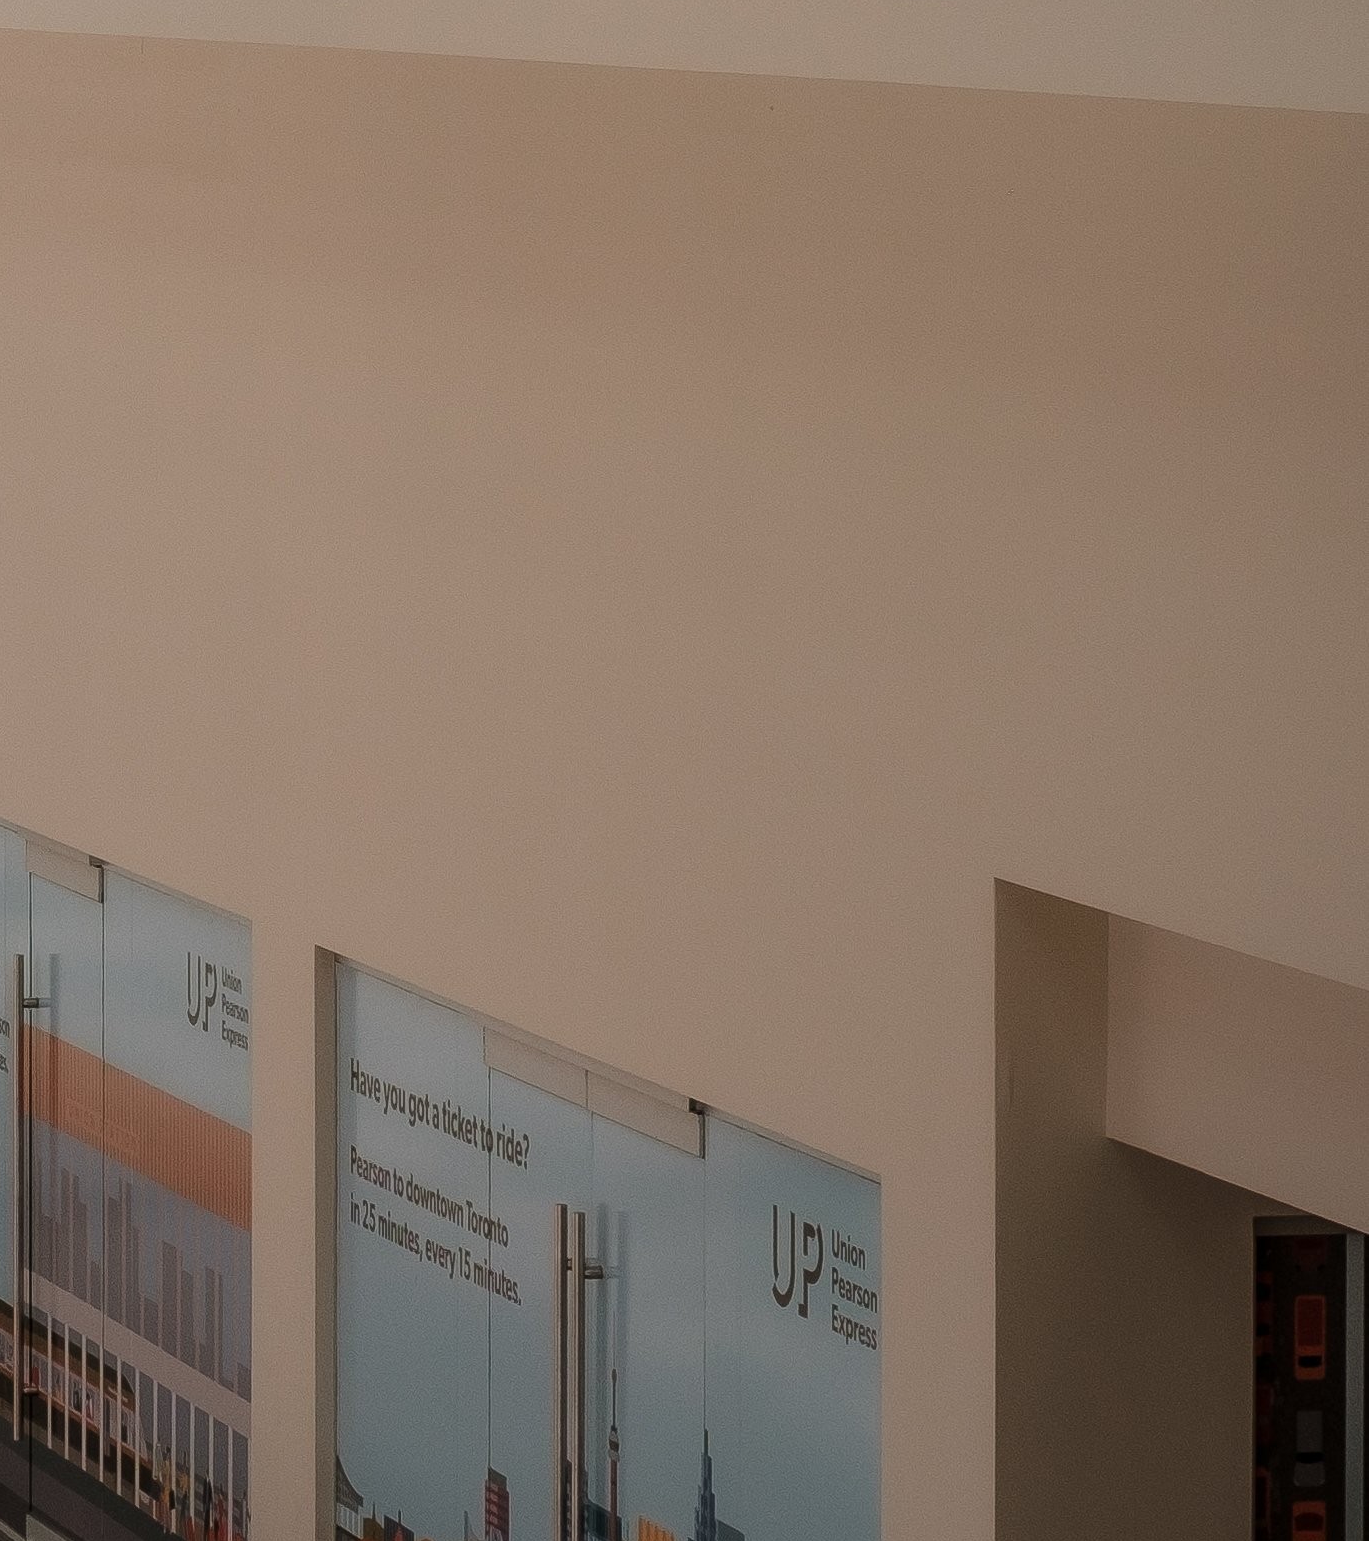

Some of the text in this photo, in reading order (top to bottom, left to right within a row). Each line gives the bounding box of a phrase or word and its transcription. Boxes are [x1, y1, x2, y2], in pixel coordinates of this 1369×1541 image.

[187, 952, 218, 1033] UP
[221, 966, 243, 995] Union
[221, 993, 249, 1024] Pearson
[221, 1020, 249, 1050] Express
[350, 1057, 530, 1170] Have you got a ticket to ride?
[350, 1144, 509, 1248] Pearson to downtown Toronto
[350, 1192, 361, 1226] in
[362, 1199, 376, 1233] 25
[378, 1210, 423, 1262] minutes,
[425, 1237, 456, 1280] every
[458, 1246, 471, 1281] 15
[832, 1228, 866, 1271] Union
[772, 1204, 824, 1319] UP
[831, 1266, 878, 1314] Pearson
[832, 1303, 878, 1351] Express
